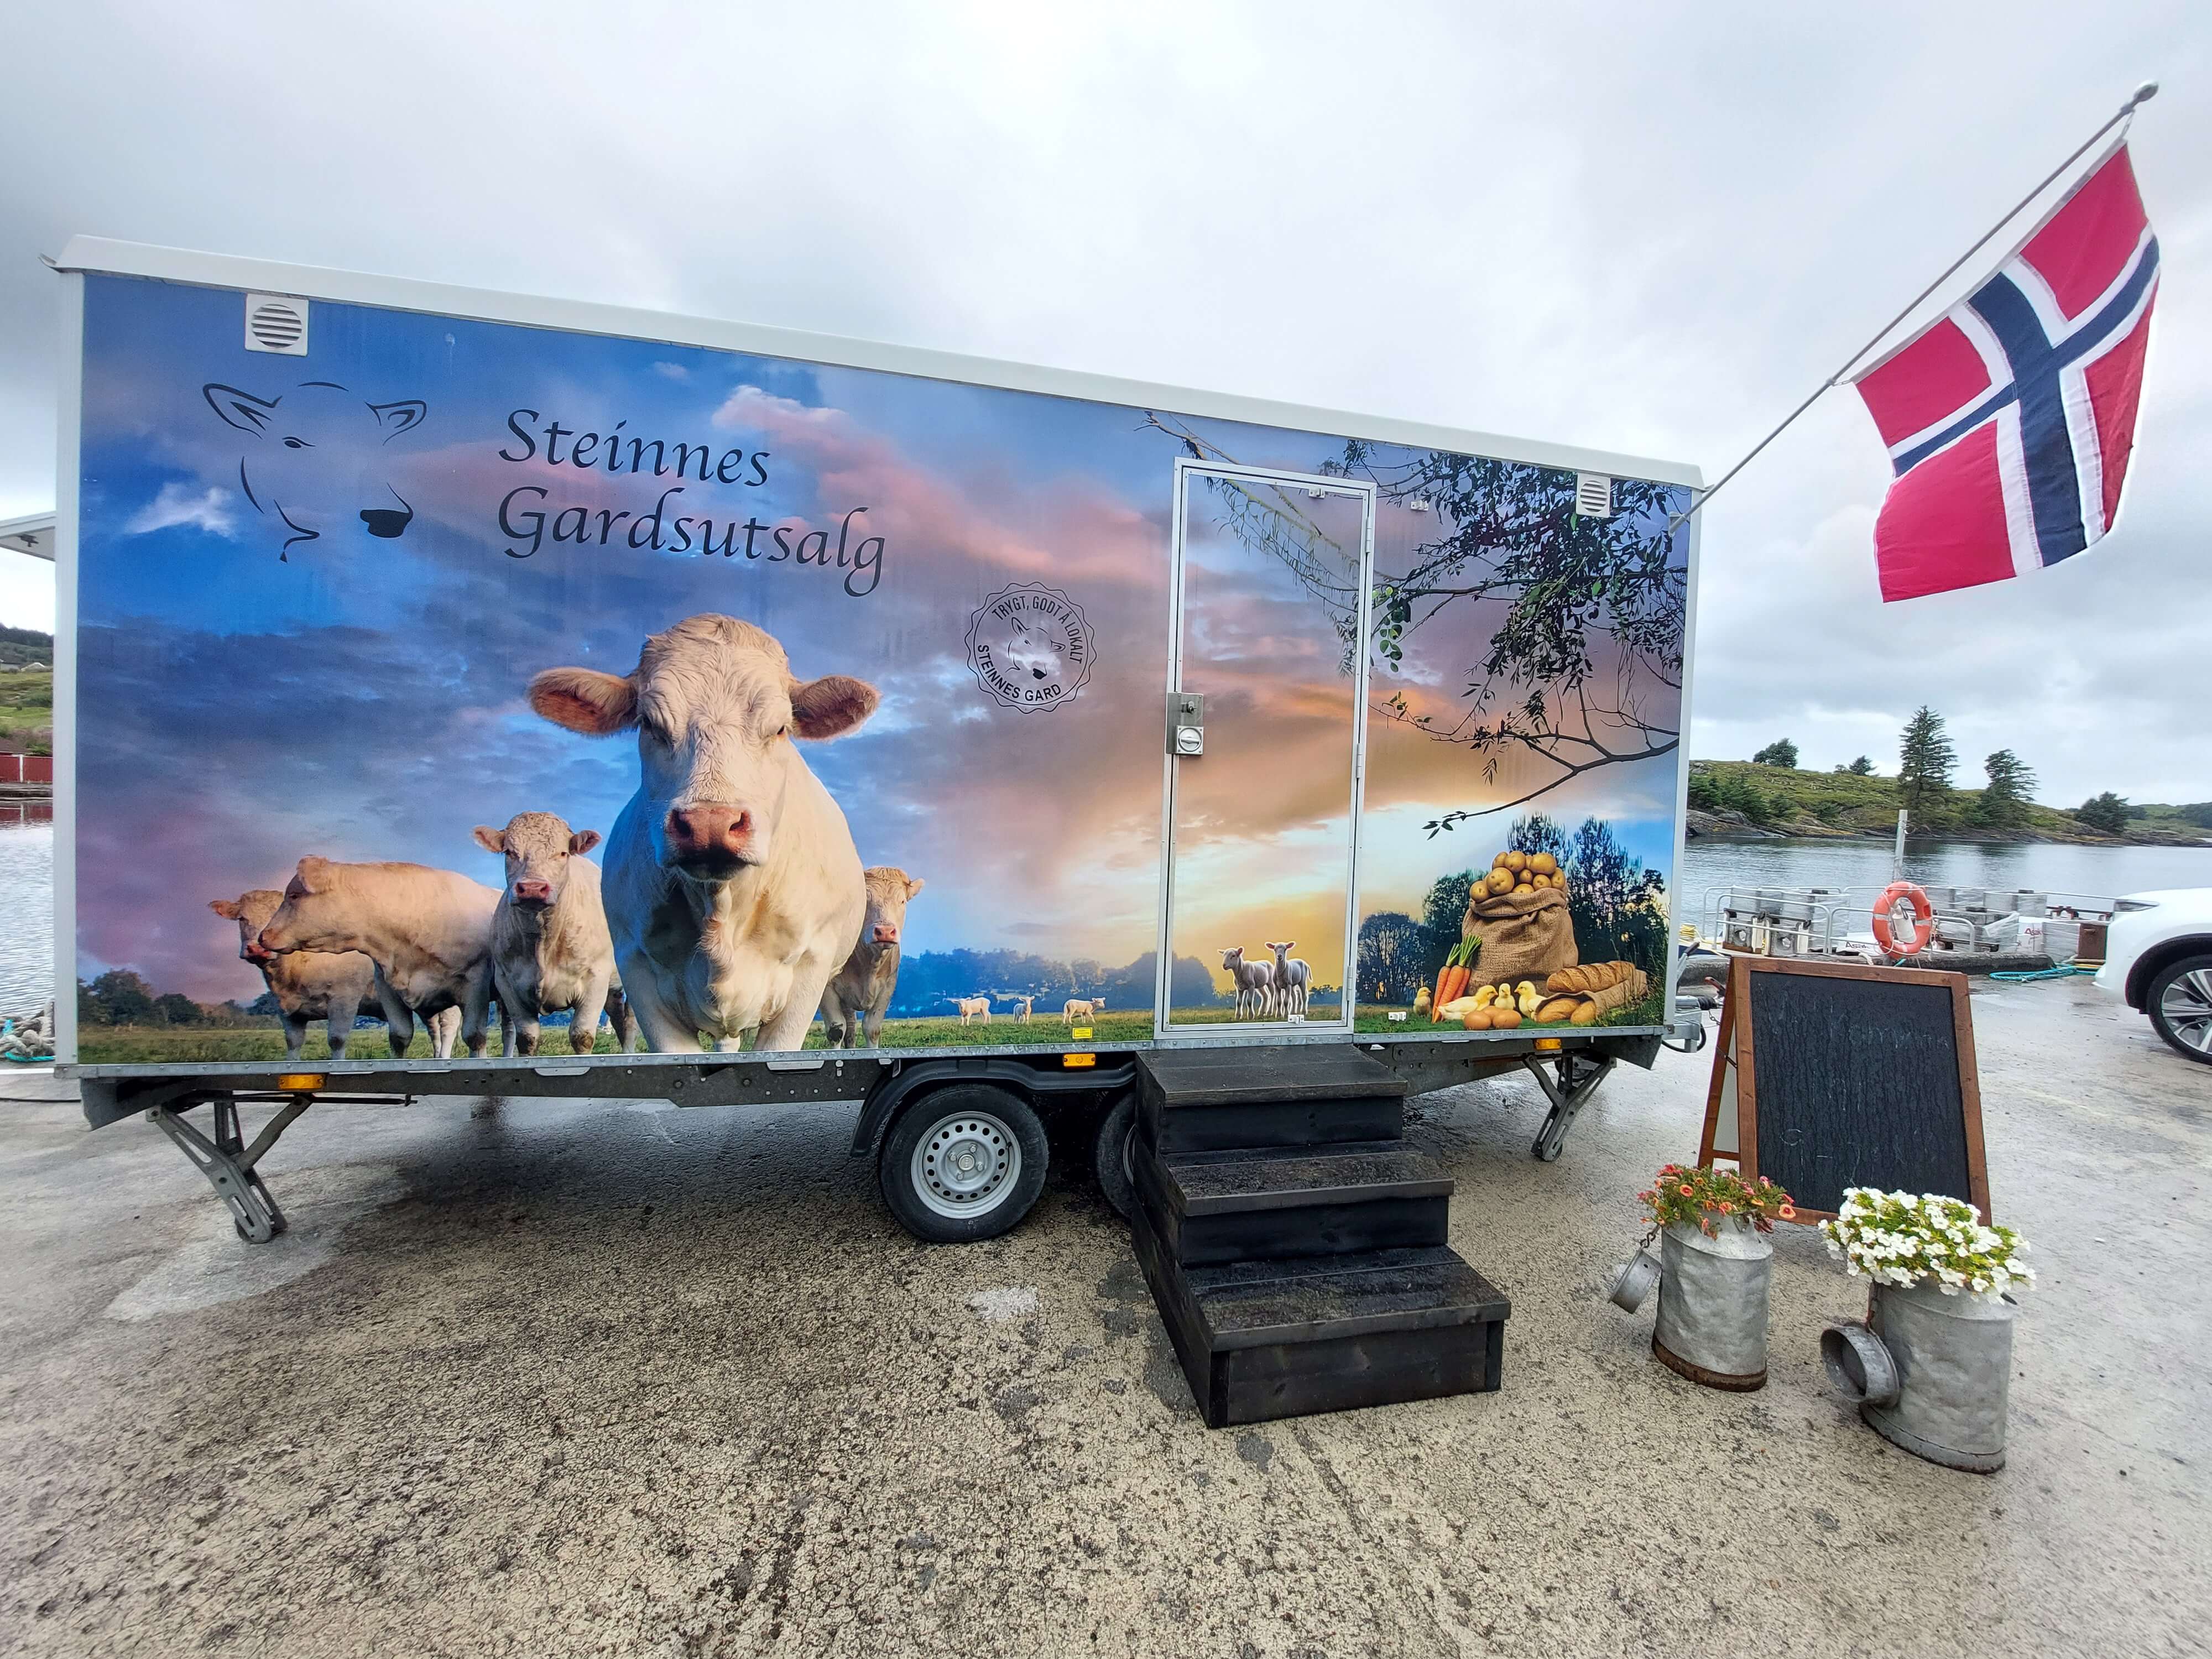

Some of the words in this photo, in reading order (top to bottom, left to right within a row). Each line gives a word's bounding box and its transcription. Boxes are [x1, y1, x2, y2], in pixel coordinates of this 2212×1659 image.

[498, 409, 771, 487] Steinnes
[498, 486, 885, 597] Gardsutsalg
[992, 596, 1029, 620] TRYGT,
[1032, 596, 1063, 617] GODT
[1058, 611, 1072, 624] Å
[1065, 622, 1083, 664] LOKALT
[978, 644, 1021, 698] STEINNES
[1025, 684, 1061, 701] GARD
